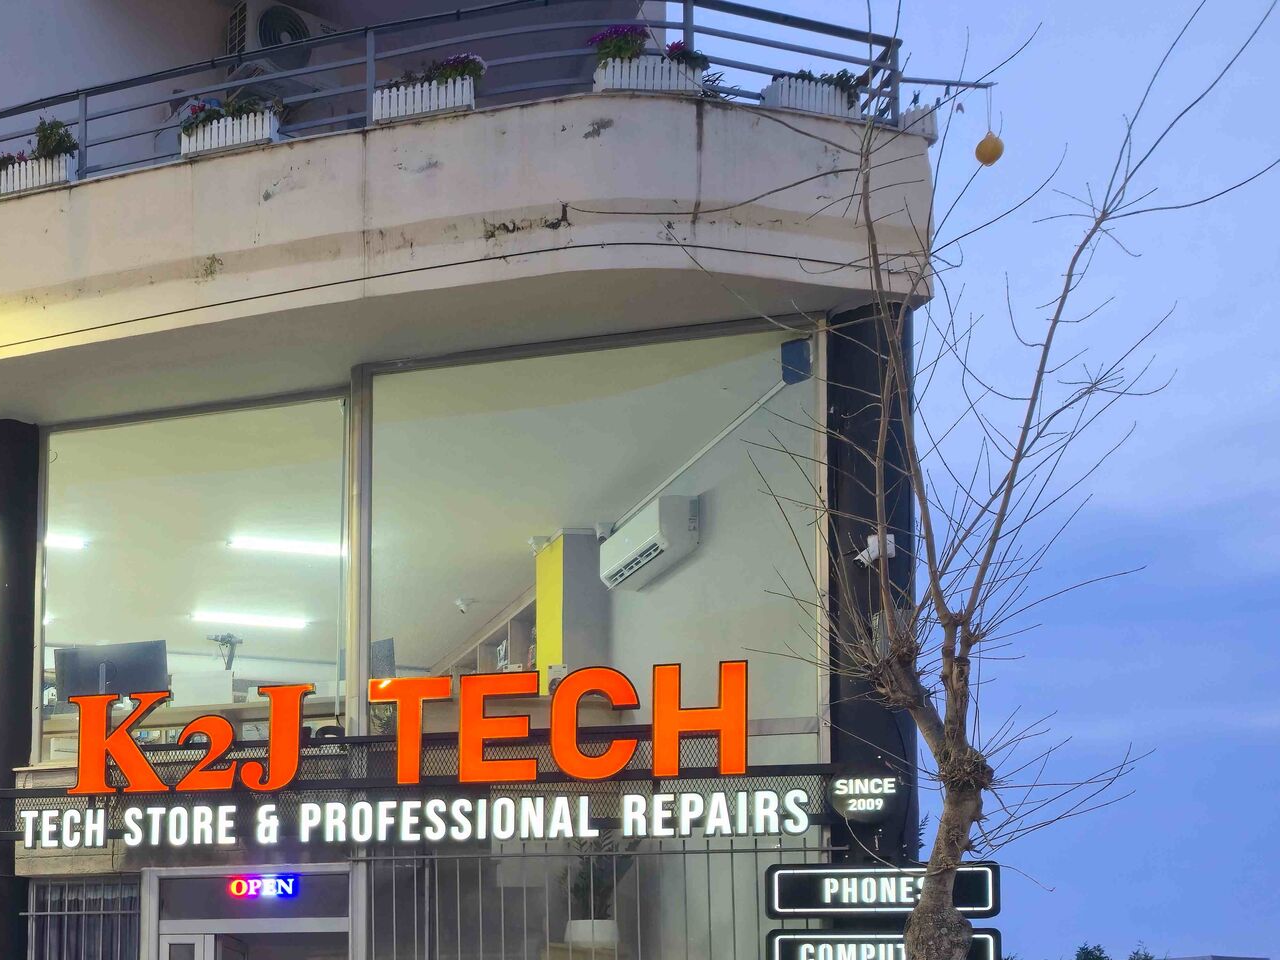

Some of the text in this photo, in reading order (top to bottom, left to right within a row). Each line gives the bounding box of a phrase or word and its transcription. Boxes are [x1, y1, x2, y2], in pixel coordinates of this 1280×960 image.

[67, 660, 748, 795] K2J TECH
[834, 777, 897, 811] SINCE 2009
[20, 788, 811, 849] TECH STORE & PROFESSIONAL REPAIRS
[230, 878, 295, 896] OPEN
